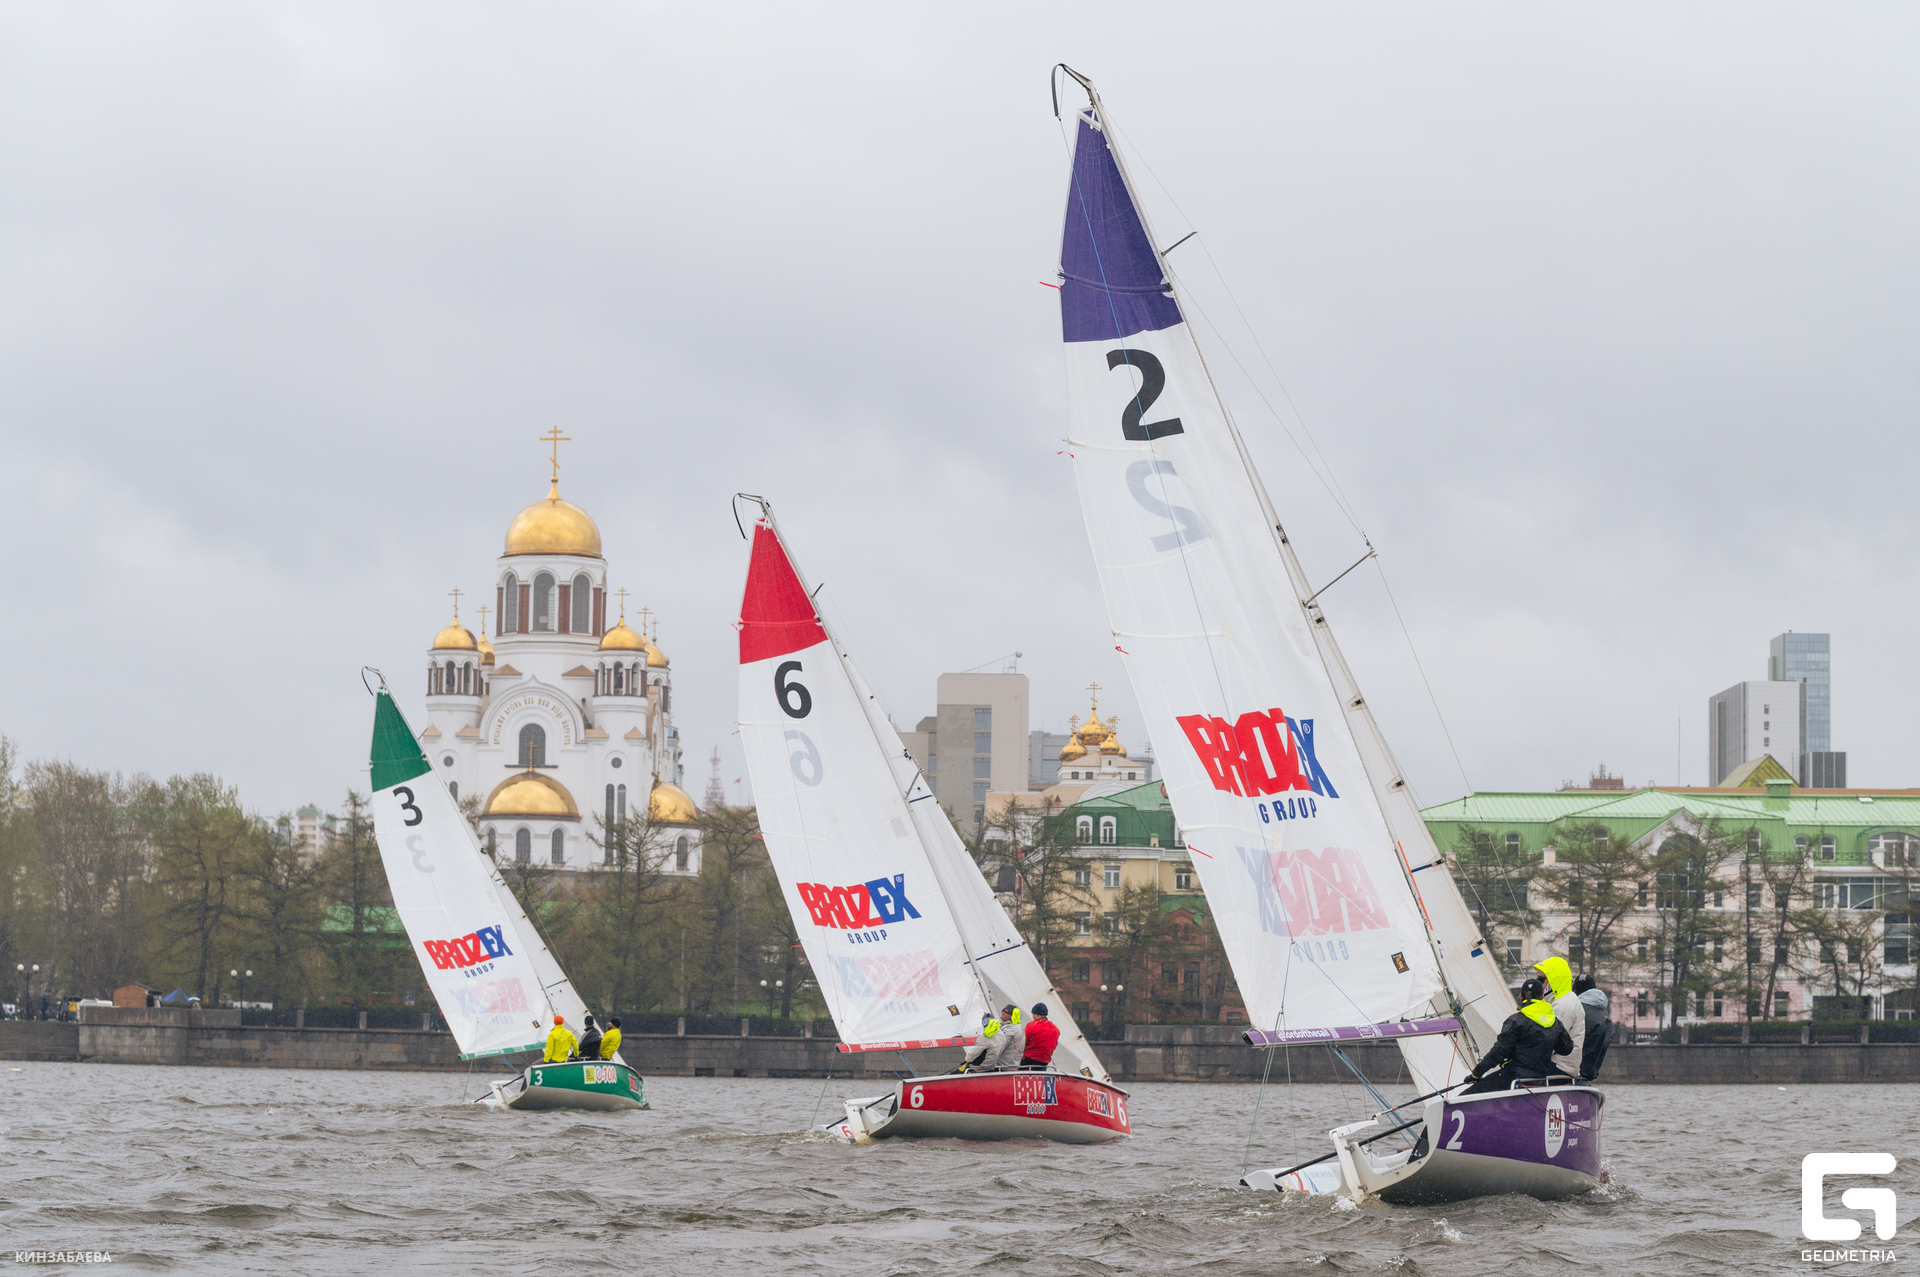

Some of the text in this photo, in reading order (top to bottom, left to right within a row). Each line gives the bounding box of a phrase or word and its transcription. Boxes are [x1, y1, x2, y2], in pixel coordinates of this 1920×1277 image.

[1106, 348, 1185, 441] 2
[774, 660, 812, 719] 6
[1175, 708, 1340, 799] BROZEX
[392, 786, 423, 827] 3
[1258, 797, 1318, 824] GROUP
[796, 873, 922, 930] BROZEX
[423, 924, 514, 970] BROZEX
[847, 928, 888, 945] GROUP
[464, 962, 495, 978] GROUP
[534, 1069, 543, 1086] 3
[1014, 1075, 1058, 1106] BROZEX
[910, 1085, 924, 1109] 6
[1117, 1097, 1127, 1127] 6
[1446, 1109, 1466, 1150] 2
